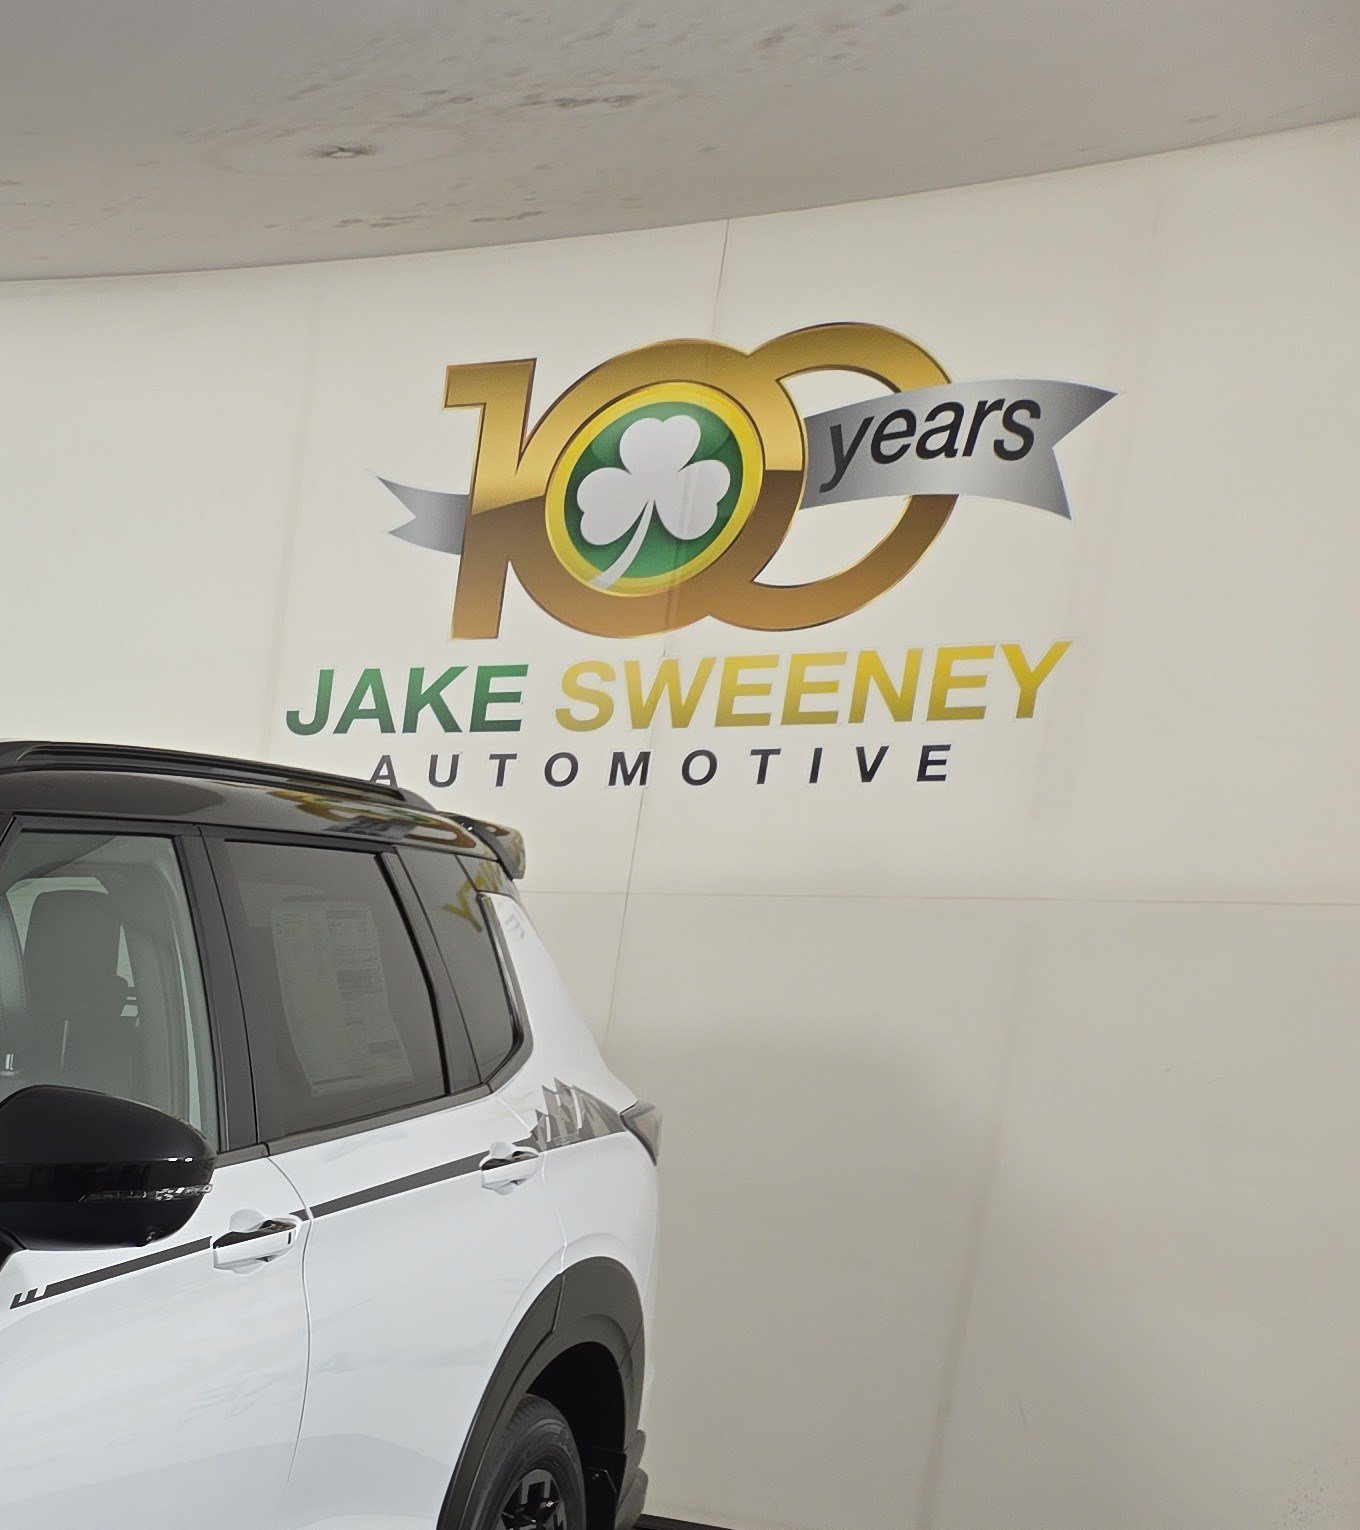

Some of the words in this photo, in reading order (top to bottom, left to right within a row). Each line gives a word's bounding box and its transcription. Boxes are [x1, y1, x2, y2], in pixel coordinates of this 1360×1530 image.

[443, 321, 958, 641] 100
[819, 398, 1041, 493] years
[285, 663, 529, 737] JAKE
[555, 641, 1073, 732] SWEENEY
[369, 744, 952, 789] AUTOMOTIVE
